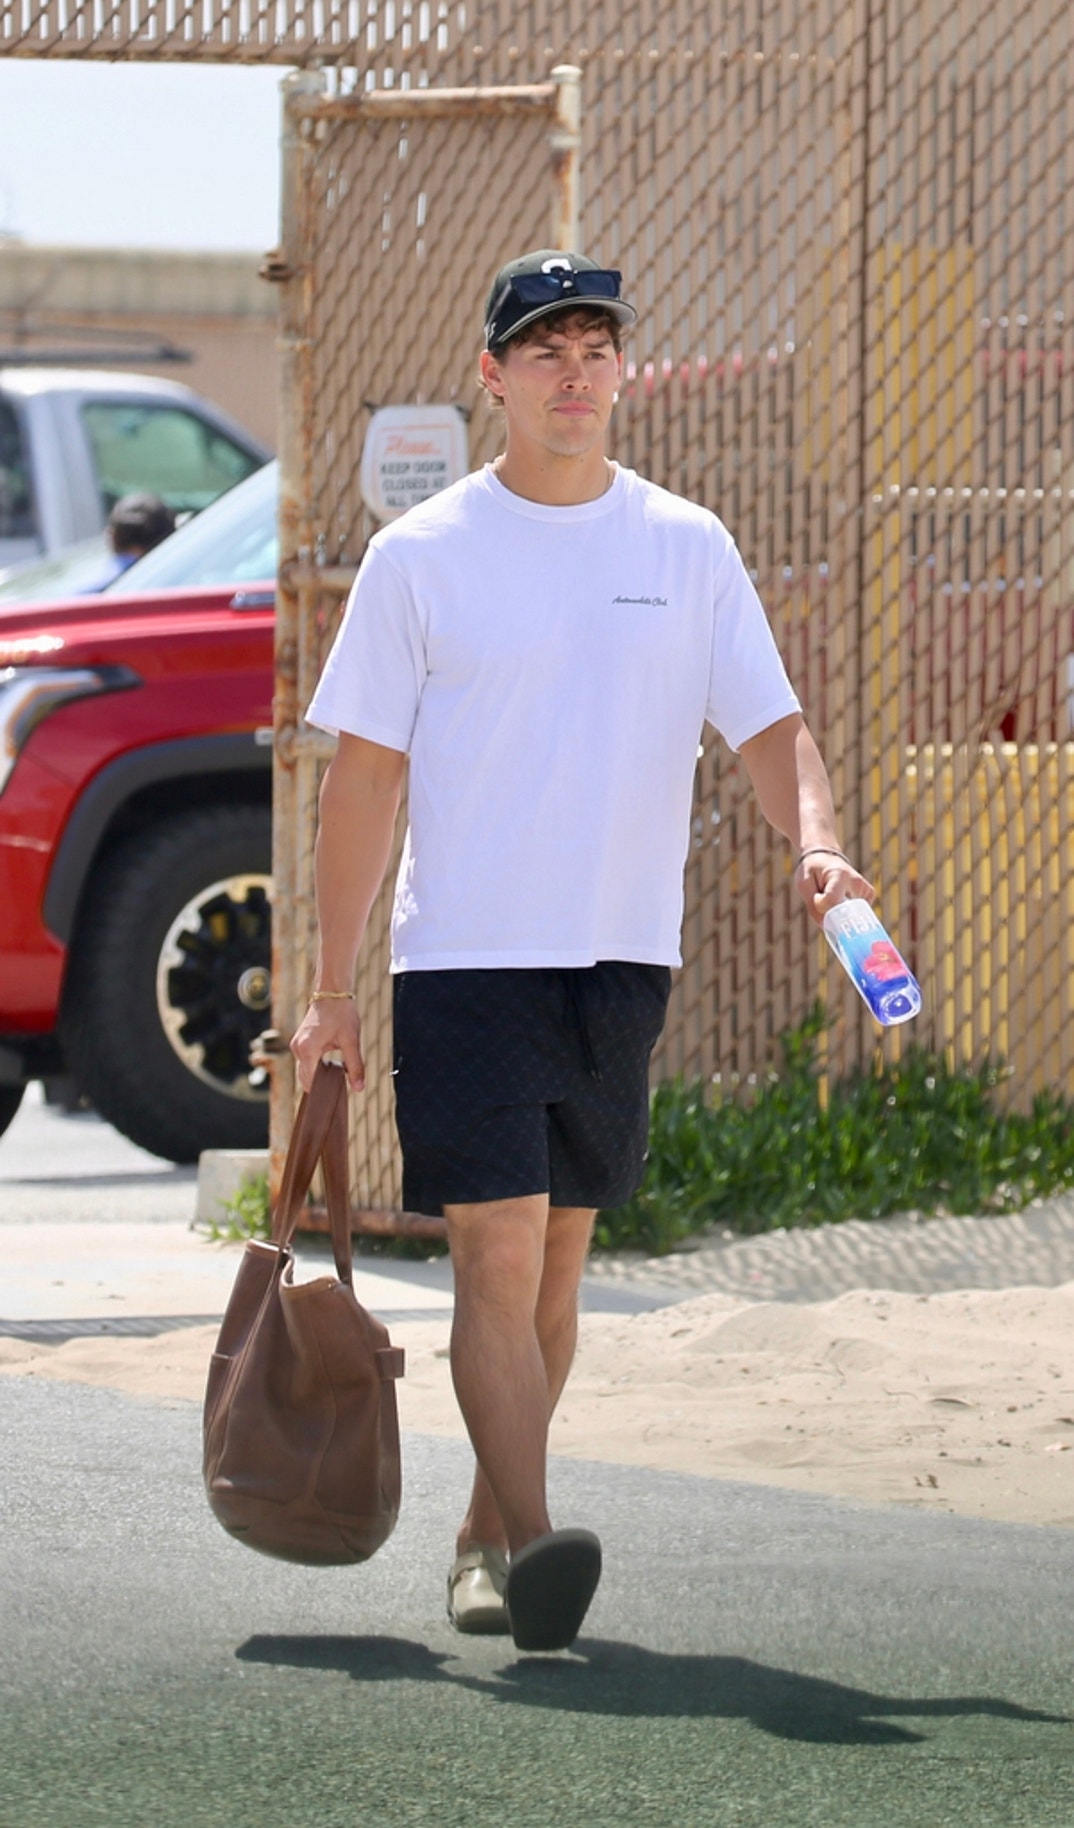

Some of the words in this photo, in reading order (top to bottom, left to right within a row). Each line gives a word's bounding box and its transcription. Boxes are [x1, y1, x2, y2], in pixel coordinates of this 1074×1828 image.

[380, 462, 410, 474] KEEP
[414, 461, 446, 473] DOOR
[382, 479, 428, 491] CLOSED
